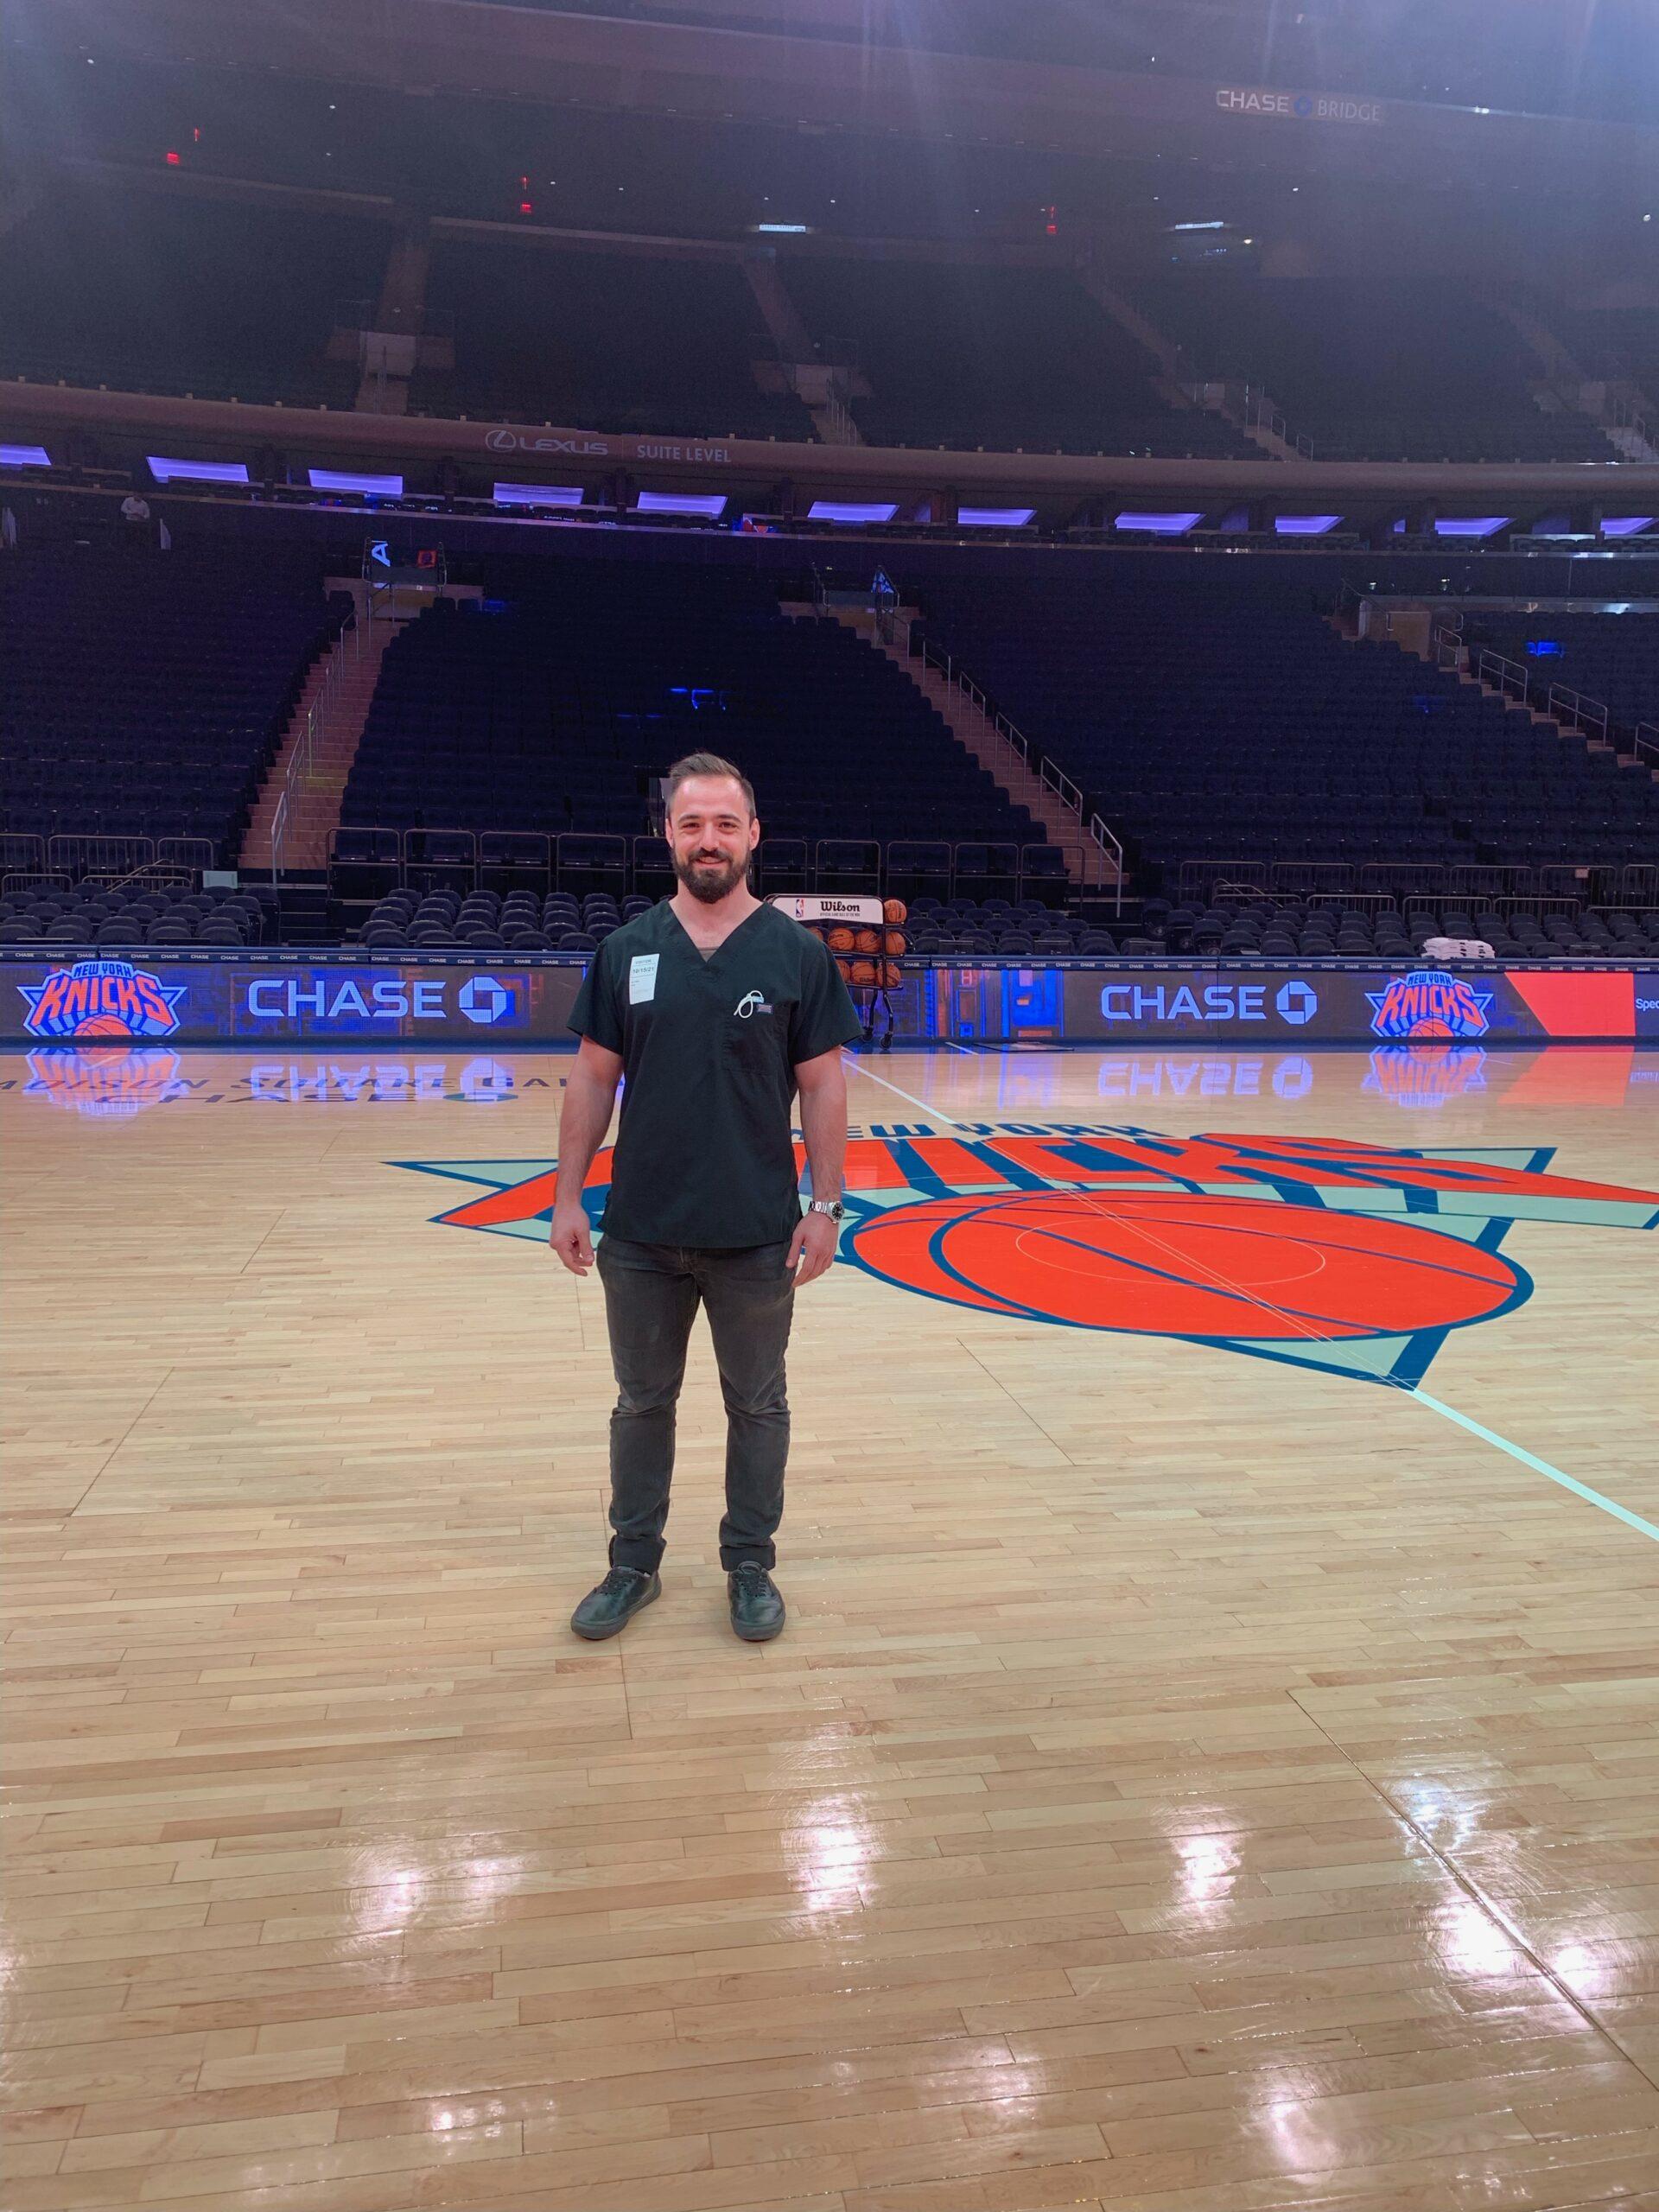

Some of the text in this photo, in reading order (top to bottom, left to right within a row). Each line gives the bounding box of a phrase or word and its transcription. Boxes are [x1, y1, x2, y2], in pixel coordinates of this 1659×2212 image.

[1216, 90, 1381, 121] CHASE BRIDGE
[519, 436, 608, 456] LEXUS
[637, 444, 731, 463] SUITE LEVEL
[820, 900, 861, 912] Wilson
[73, 963, 132, 977] NEW YORK
[1408, 973, 1452, 985] NEW YORK
[31, 976, 175, 1027] KNICKS
[248, 979, 448, 1018] CHASE
[1101, 985, 1268, 1020] CHASE
[1376, 983, 1483, 1027] KNICKS
[231, 1077, 456, 1089] SQUARE
[95, 1094, 418, 1103] CHASE
[953, 1123, 1173, 1137] YORK
